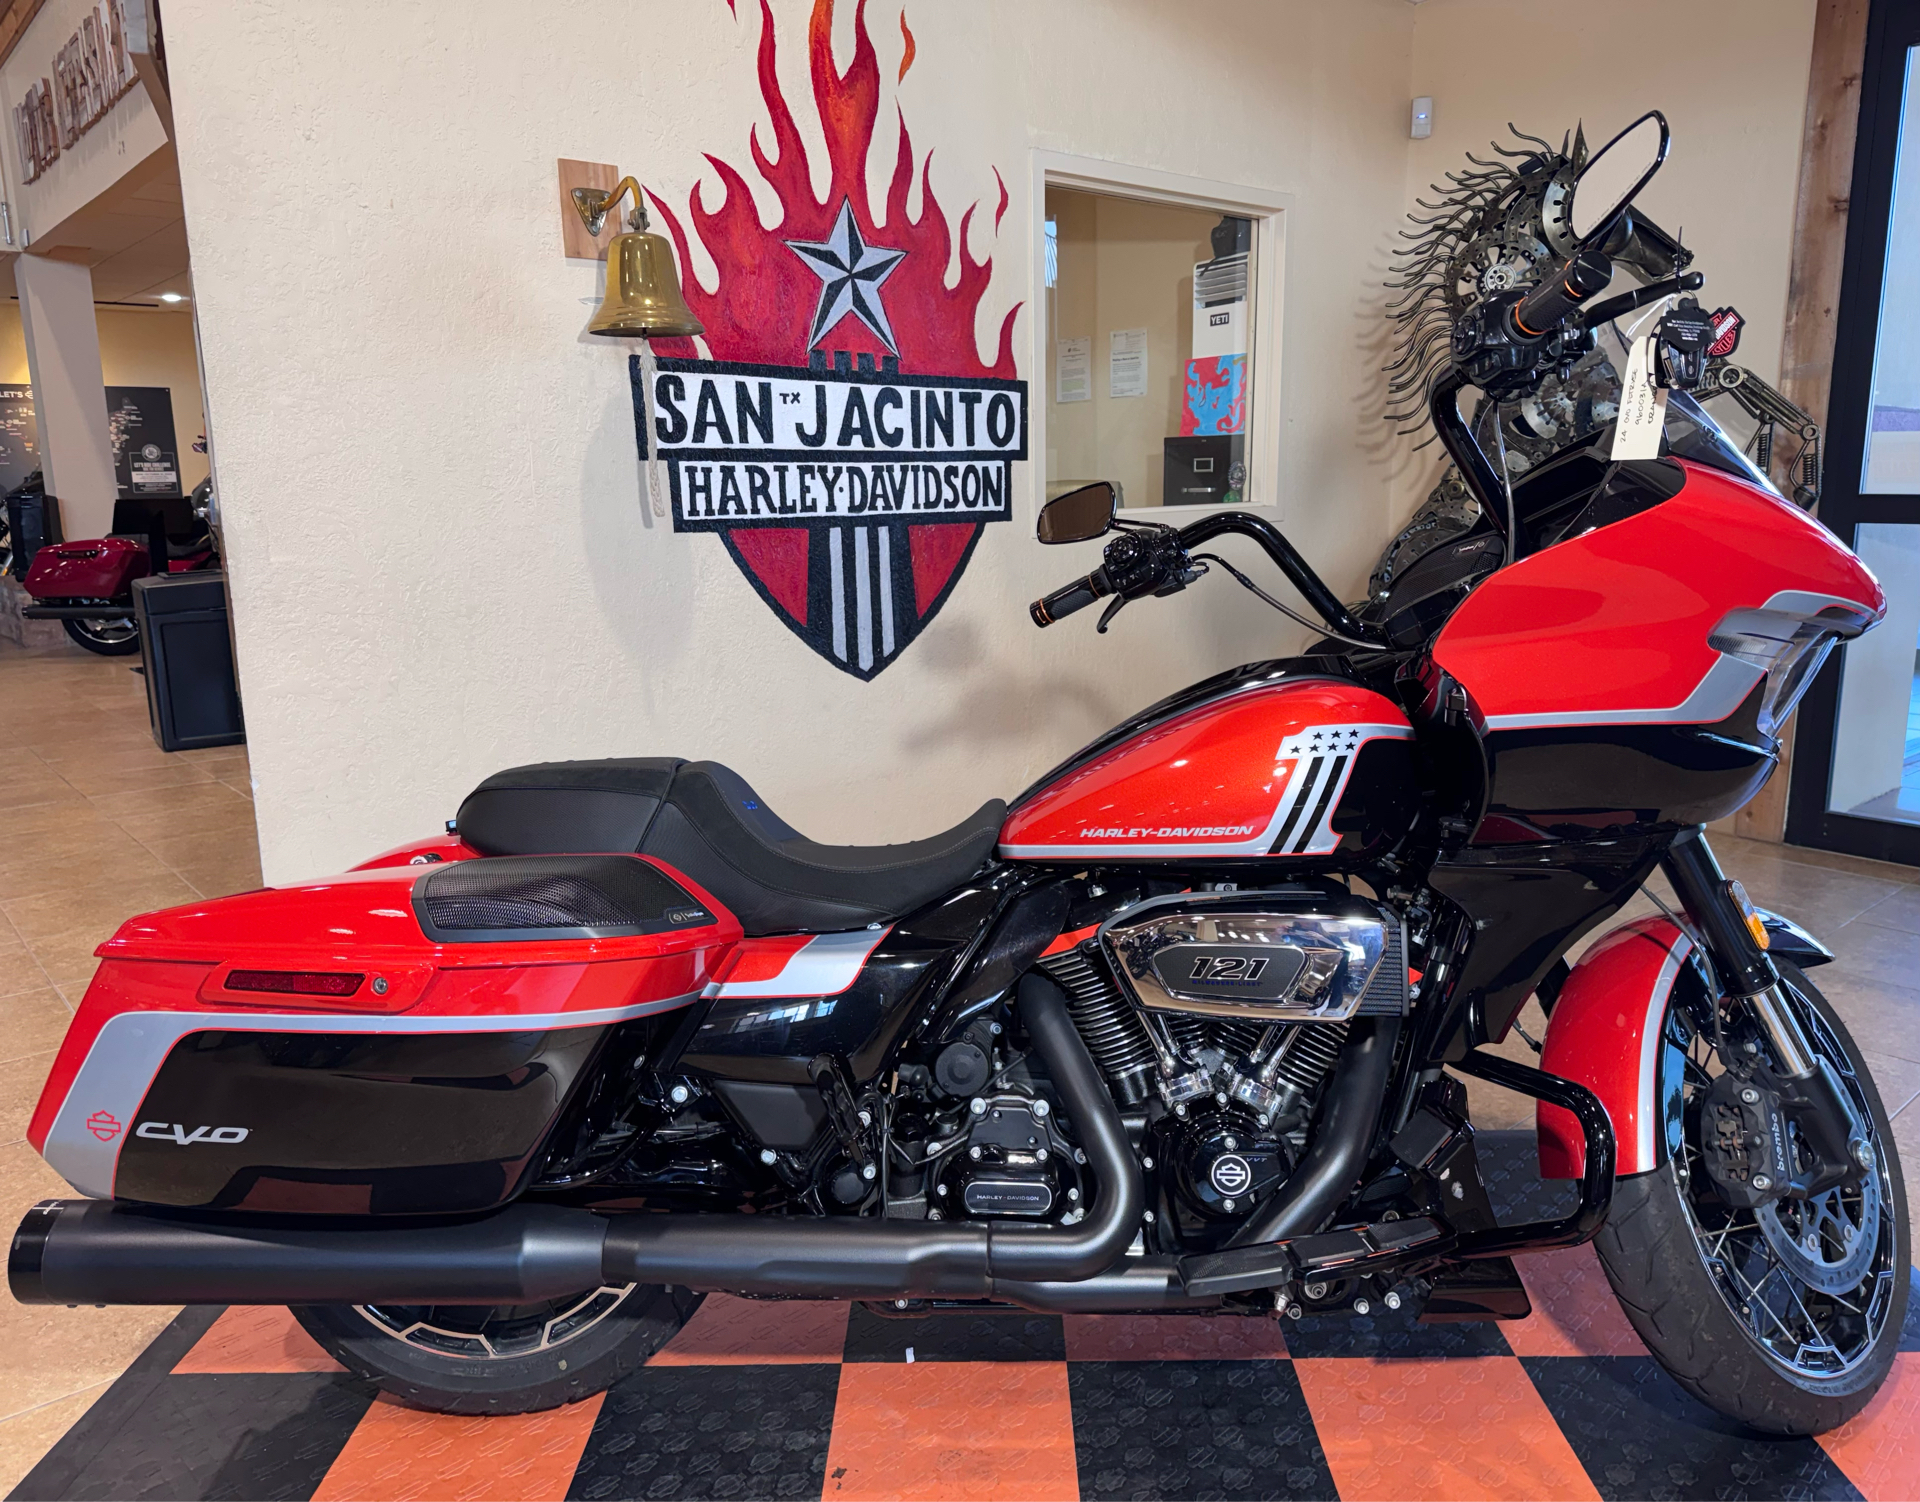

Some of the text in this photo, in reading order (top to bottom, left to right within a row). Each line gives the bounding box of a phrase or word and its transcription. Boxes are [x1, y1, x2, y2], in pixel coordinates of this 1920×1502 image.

[1211, 314, 1228, 325] YETI
[655, 373, 1016, 448] SAN TX JACINTO
[1080, 825, 1254, 838] HARLEY-DAVIDSON
[1189, 956, 1270, 980] 121
[135, 1121, 249, 1146] CVO
[1771, 1113, 1785, 1171] brembo
